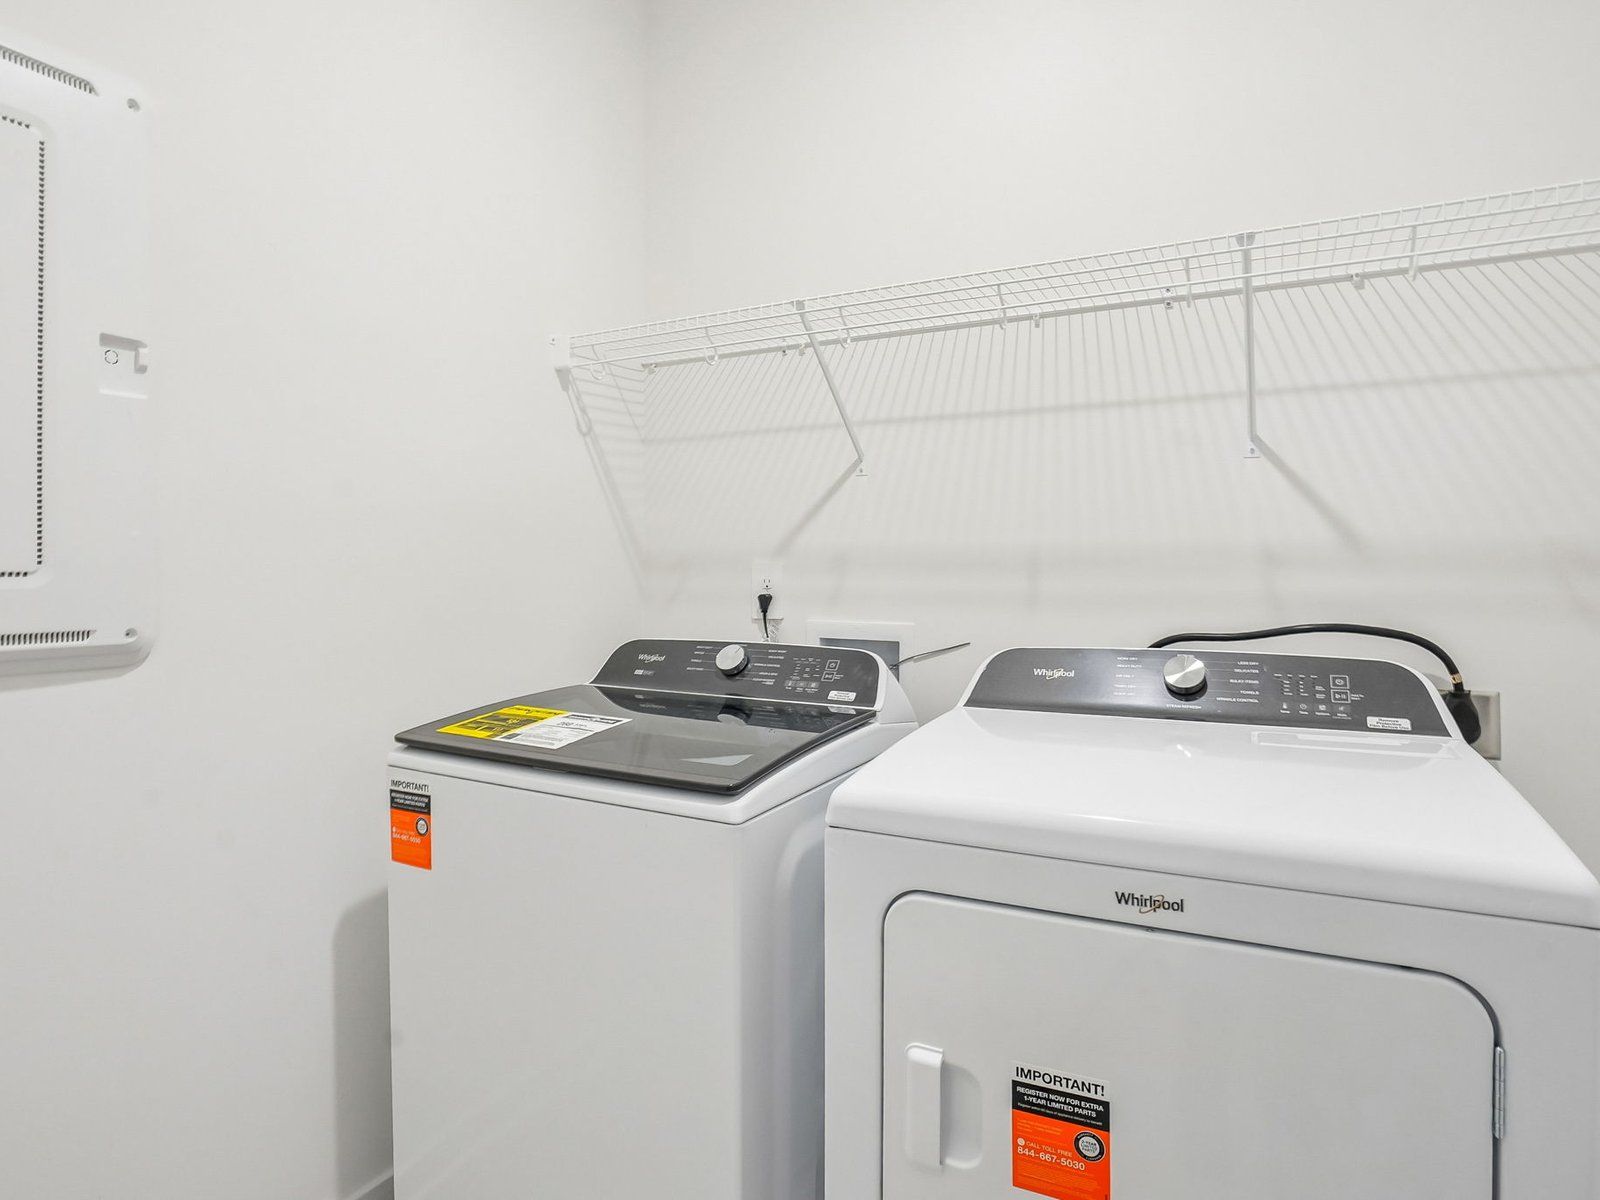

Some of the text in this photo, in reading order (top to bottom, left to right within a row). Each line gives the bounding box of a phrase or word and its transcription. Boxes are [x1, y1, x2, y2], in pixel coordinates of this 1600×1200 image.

[1033, 668, 1075, 679] Whirlpool
[391, 780, 430, 792] IMPORTANT!
[1115, 891, 1184, 914] Whirlpool
[1016, 1066, 1105, 1097] IMPORTANT!
[1016, 1086, 1104, 1112] REGISTER NOW FOR EXTRA
[1024, 1096, 1046, 1106] 1-YEAR
[1047, 1101, 1073, 1112] LIMITED
[1074, 1108, 1097, 1118] PARTS
[1017, 1146, 1086, 1171] 844-667-5030
[1026, 1141, 1073, 1157] CALL TOLL FREE
